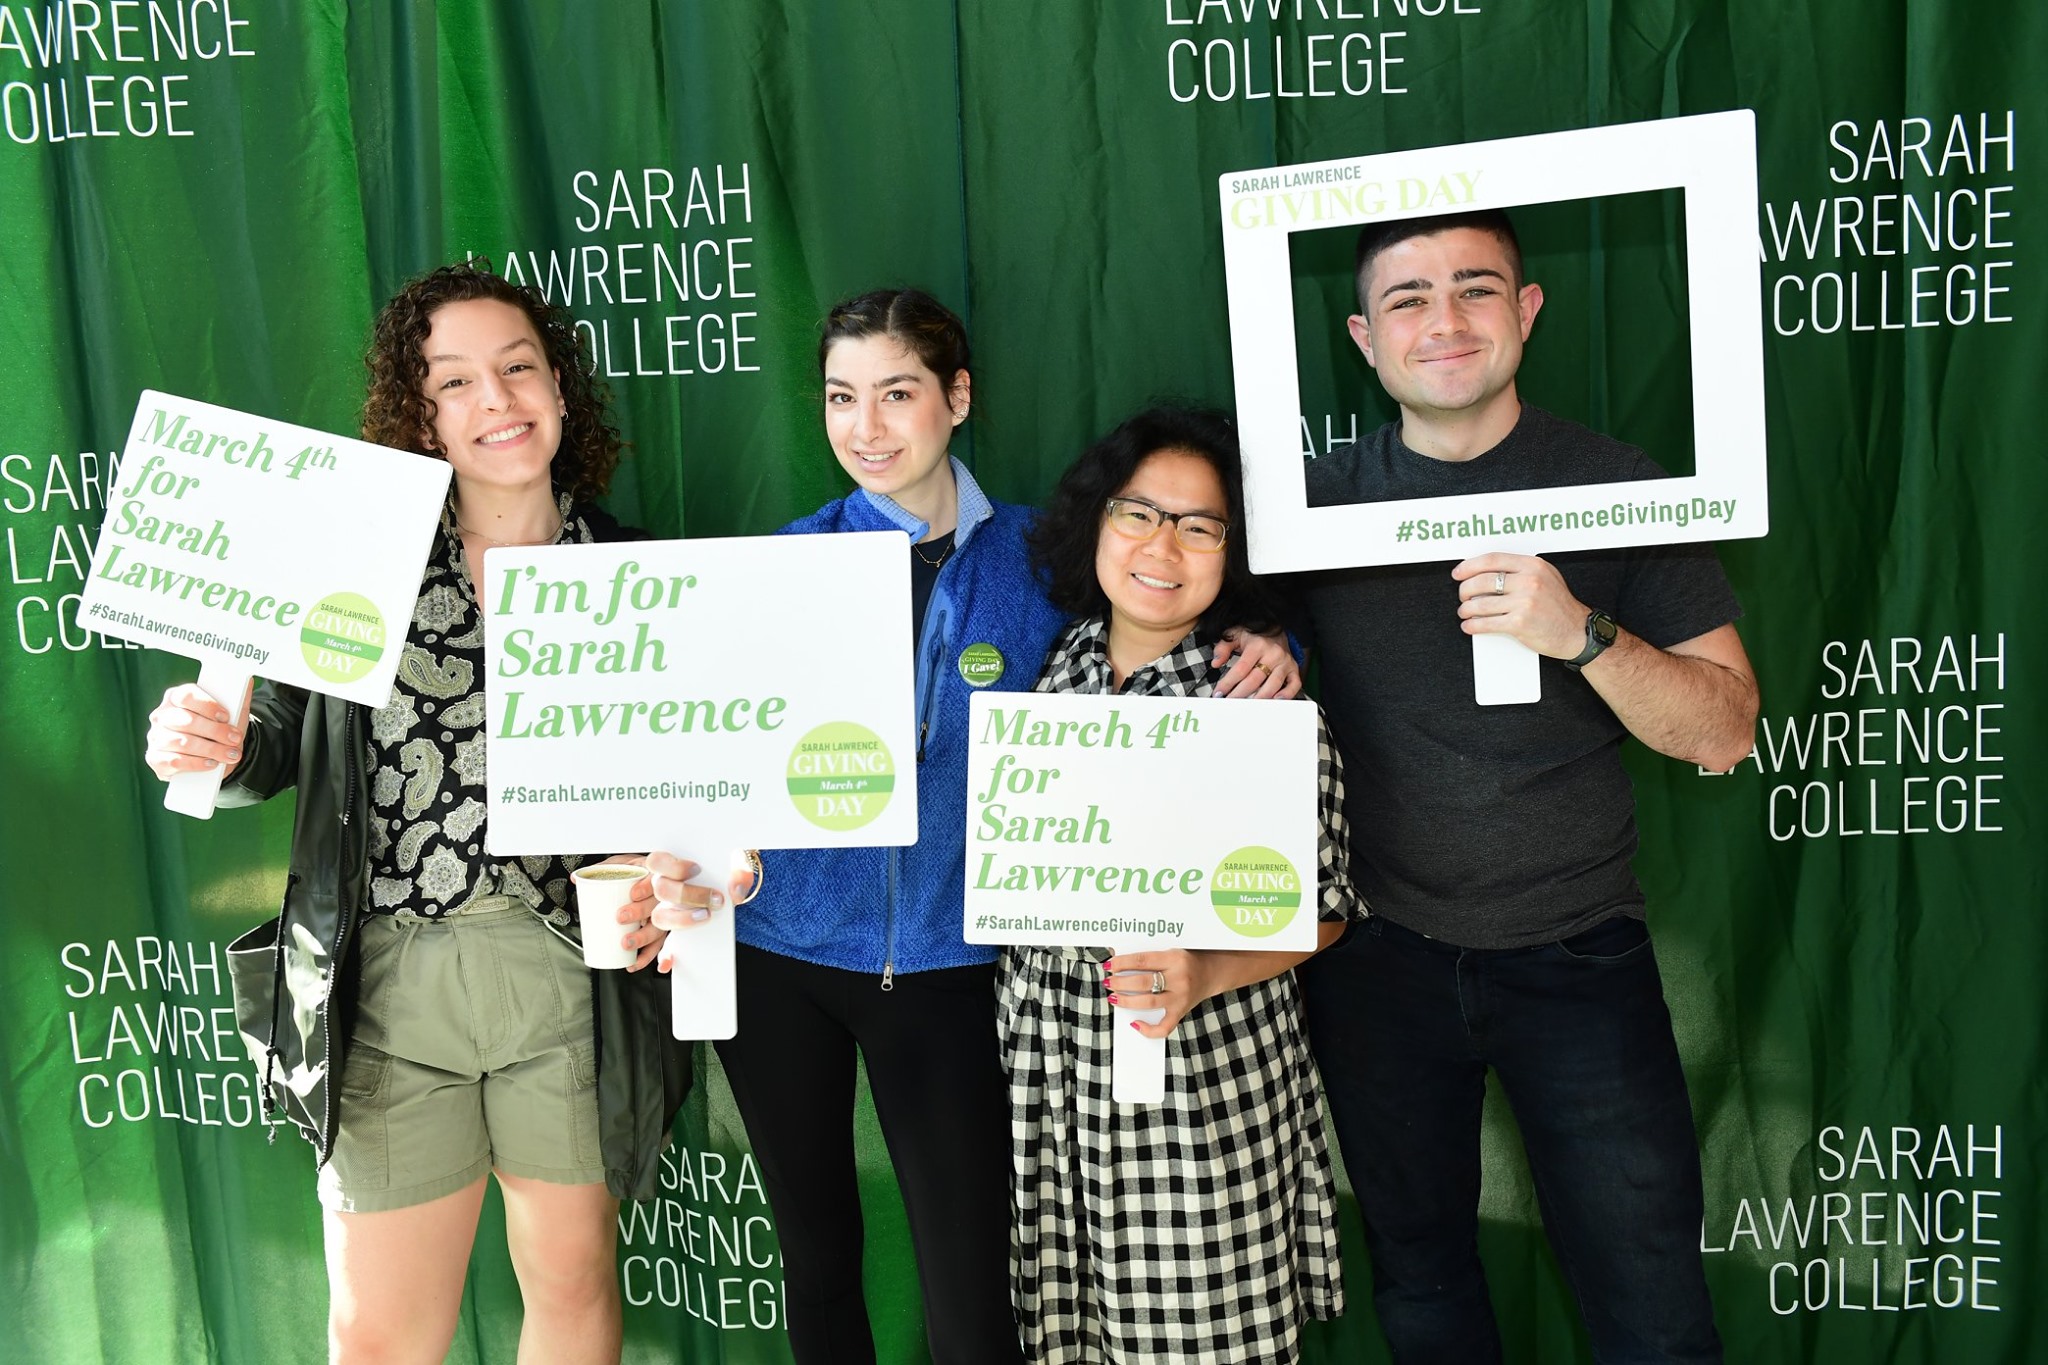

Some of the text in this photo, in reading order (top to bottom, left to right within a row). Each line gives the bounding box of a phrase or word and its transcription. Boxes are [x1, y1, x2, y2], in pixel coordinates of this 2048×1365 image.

[0, 0, 256, 69] AWRENCE
[1167, 31, 1408, 103] COLLEGE
[2, 75, 195, 144] OLLEGE
[1829, 110, 2014, 183] SARAH
[572, 163, 752, 233] SARAH
[1230, 170, 1484, 231] GIVING DAY
[1231, 165, 1362, 194] SARAH LAWRENCE
[1759, 186, 2014, 263] WRENCE
[466, 237, 757, 307] AWRENCE
[1773, 261, 2014, 336] COLLEGE
[549, 311, 761, 378] OLLEGE
[138, 408, 338, 480] March 4th
[0, 451, 120, 514] SAR
[122, 455, 201, 500] for
[111, 500, 231, 561] Sarah
[1396, 497, 1738, 543] #SarahLawrenceGivingDay
[96, 544, 301, 628] Lawrence
[320, 603, 380, 625] SARAH LAWRENCE
[593, 560, 698, 626] for
[88, 602, 270, 666] #SarahLawrenceGivingDay
[309, 610, 382, 644] GIVING
[323, 637, 351, 651] March
[497, 622, 668, 678] Sarah
[316, 649, 358, 674] DAY
[970, 660, 1001, 673] Gave!
[1820, 632, 2004, 699] SARAH
[496, 690, 787, 739] Lawrence
[979, 708, 1201, 749] March 4th
[1698, 703, 2004, 776] WRENCE
[793, 751, 887, 776] GIVING
[801, 741, 879, 752] SARAH LAWRENCE
[501, 779, 751, 805] #SarahLawrenceGivingDay
[816, 795, 868, 817] DAY
[820, 779, 854, 791] March
[977, 754, 1061, 804] for
[1769, 774, 2004, 841] COLLEGE
[976, 804, 1112, 844] Sarah
[973, 853, 1204, 895] Lawrence
[1216, 871, 1295, 891] GIVING
[1224, 862, 1288, 872] SARAH LAWRENCE
[975, 914, 1184, 937] #SarahLawrenceGivingDay
[1235, 907, 1278, 926] DAY
[1238, 894, 1266, 904] March
[60, 936, 221, 999] SARAH
[69, 1001, 253, 1064] LAWRE
[660, 1143, 767, 1205] SARA
[1817, 1124, 2001, 1181] SARAH
[618, 1197, 784, 1269] WRENC
[1700, 1189, 2001, 1253] LAWRENCE
[1769, 1254, 2001, 1315] COLLEGE
